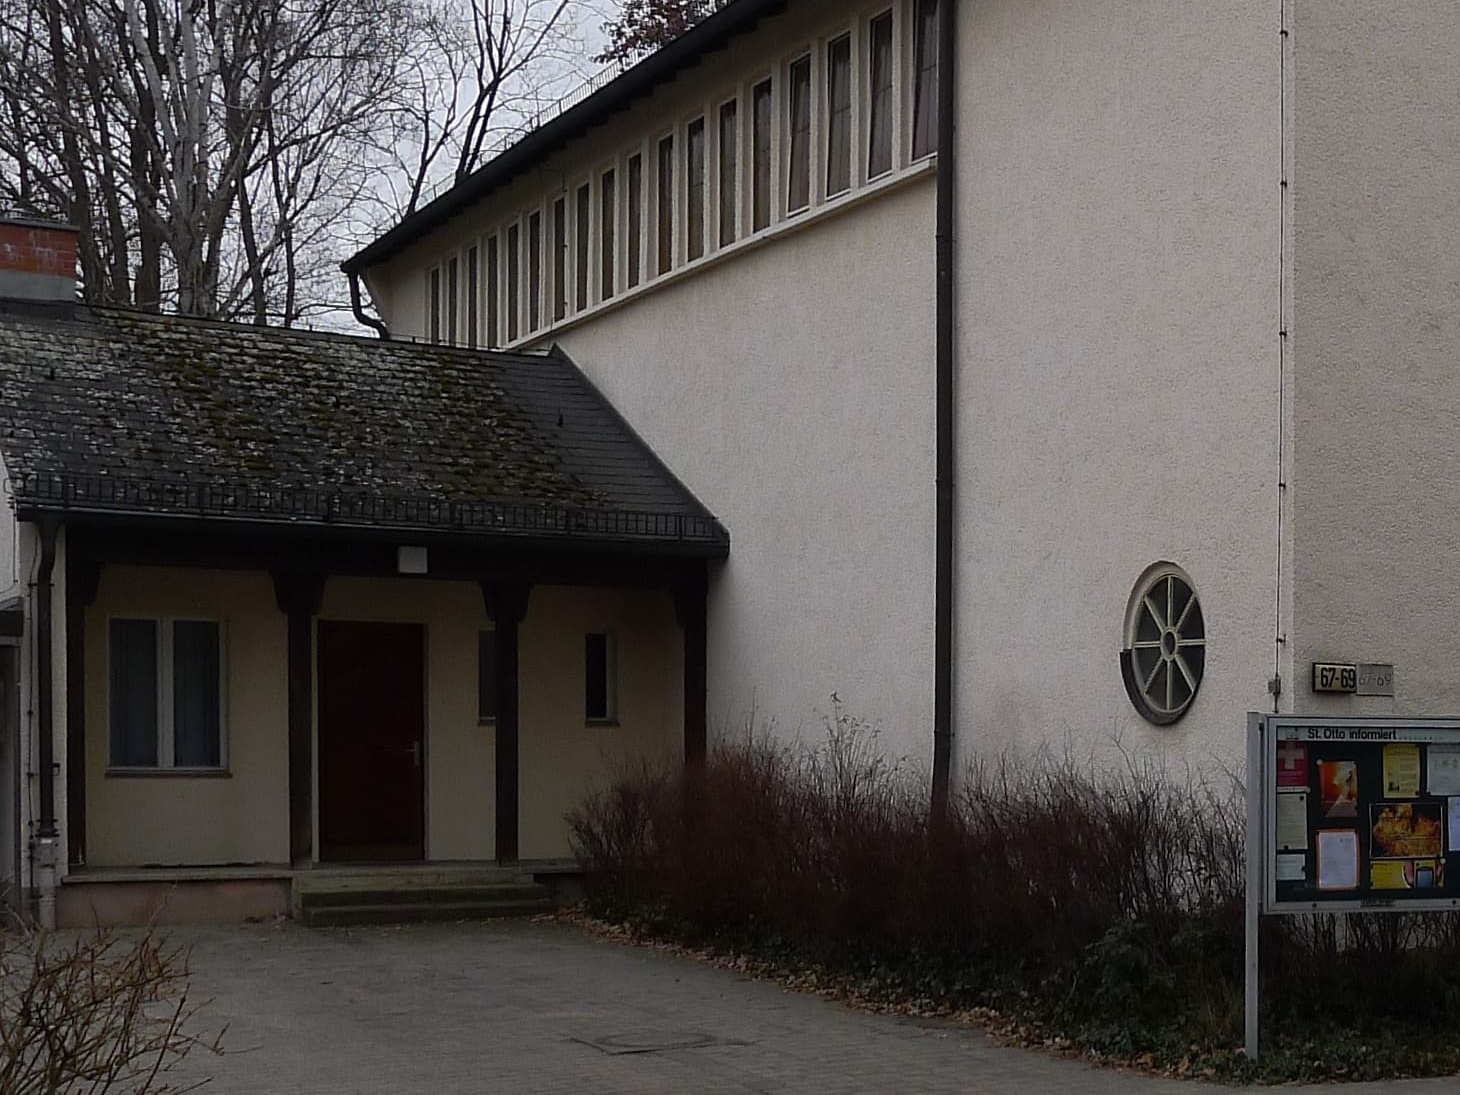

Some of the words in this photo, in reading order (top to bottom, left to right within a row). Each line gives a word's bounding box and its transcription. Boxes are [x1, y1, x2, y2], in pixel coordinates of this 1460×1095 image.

[1320, 667, 1356, 688] 67-69
[1307, 728, 1321, 740] St.
[1324, 728, 1346, 740] Otto
[1349, 728, 1397, 741] informiert
